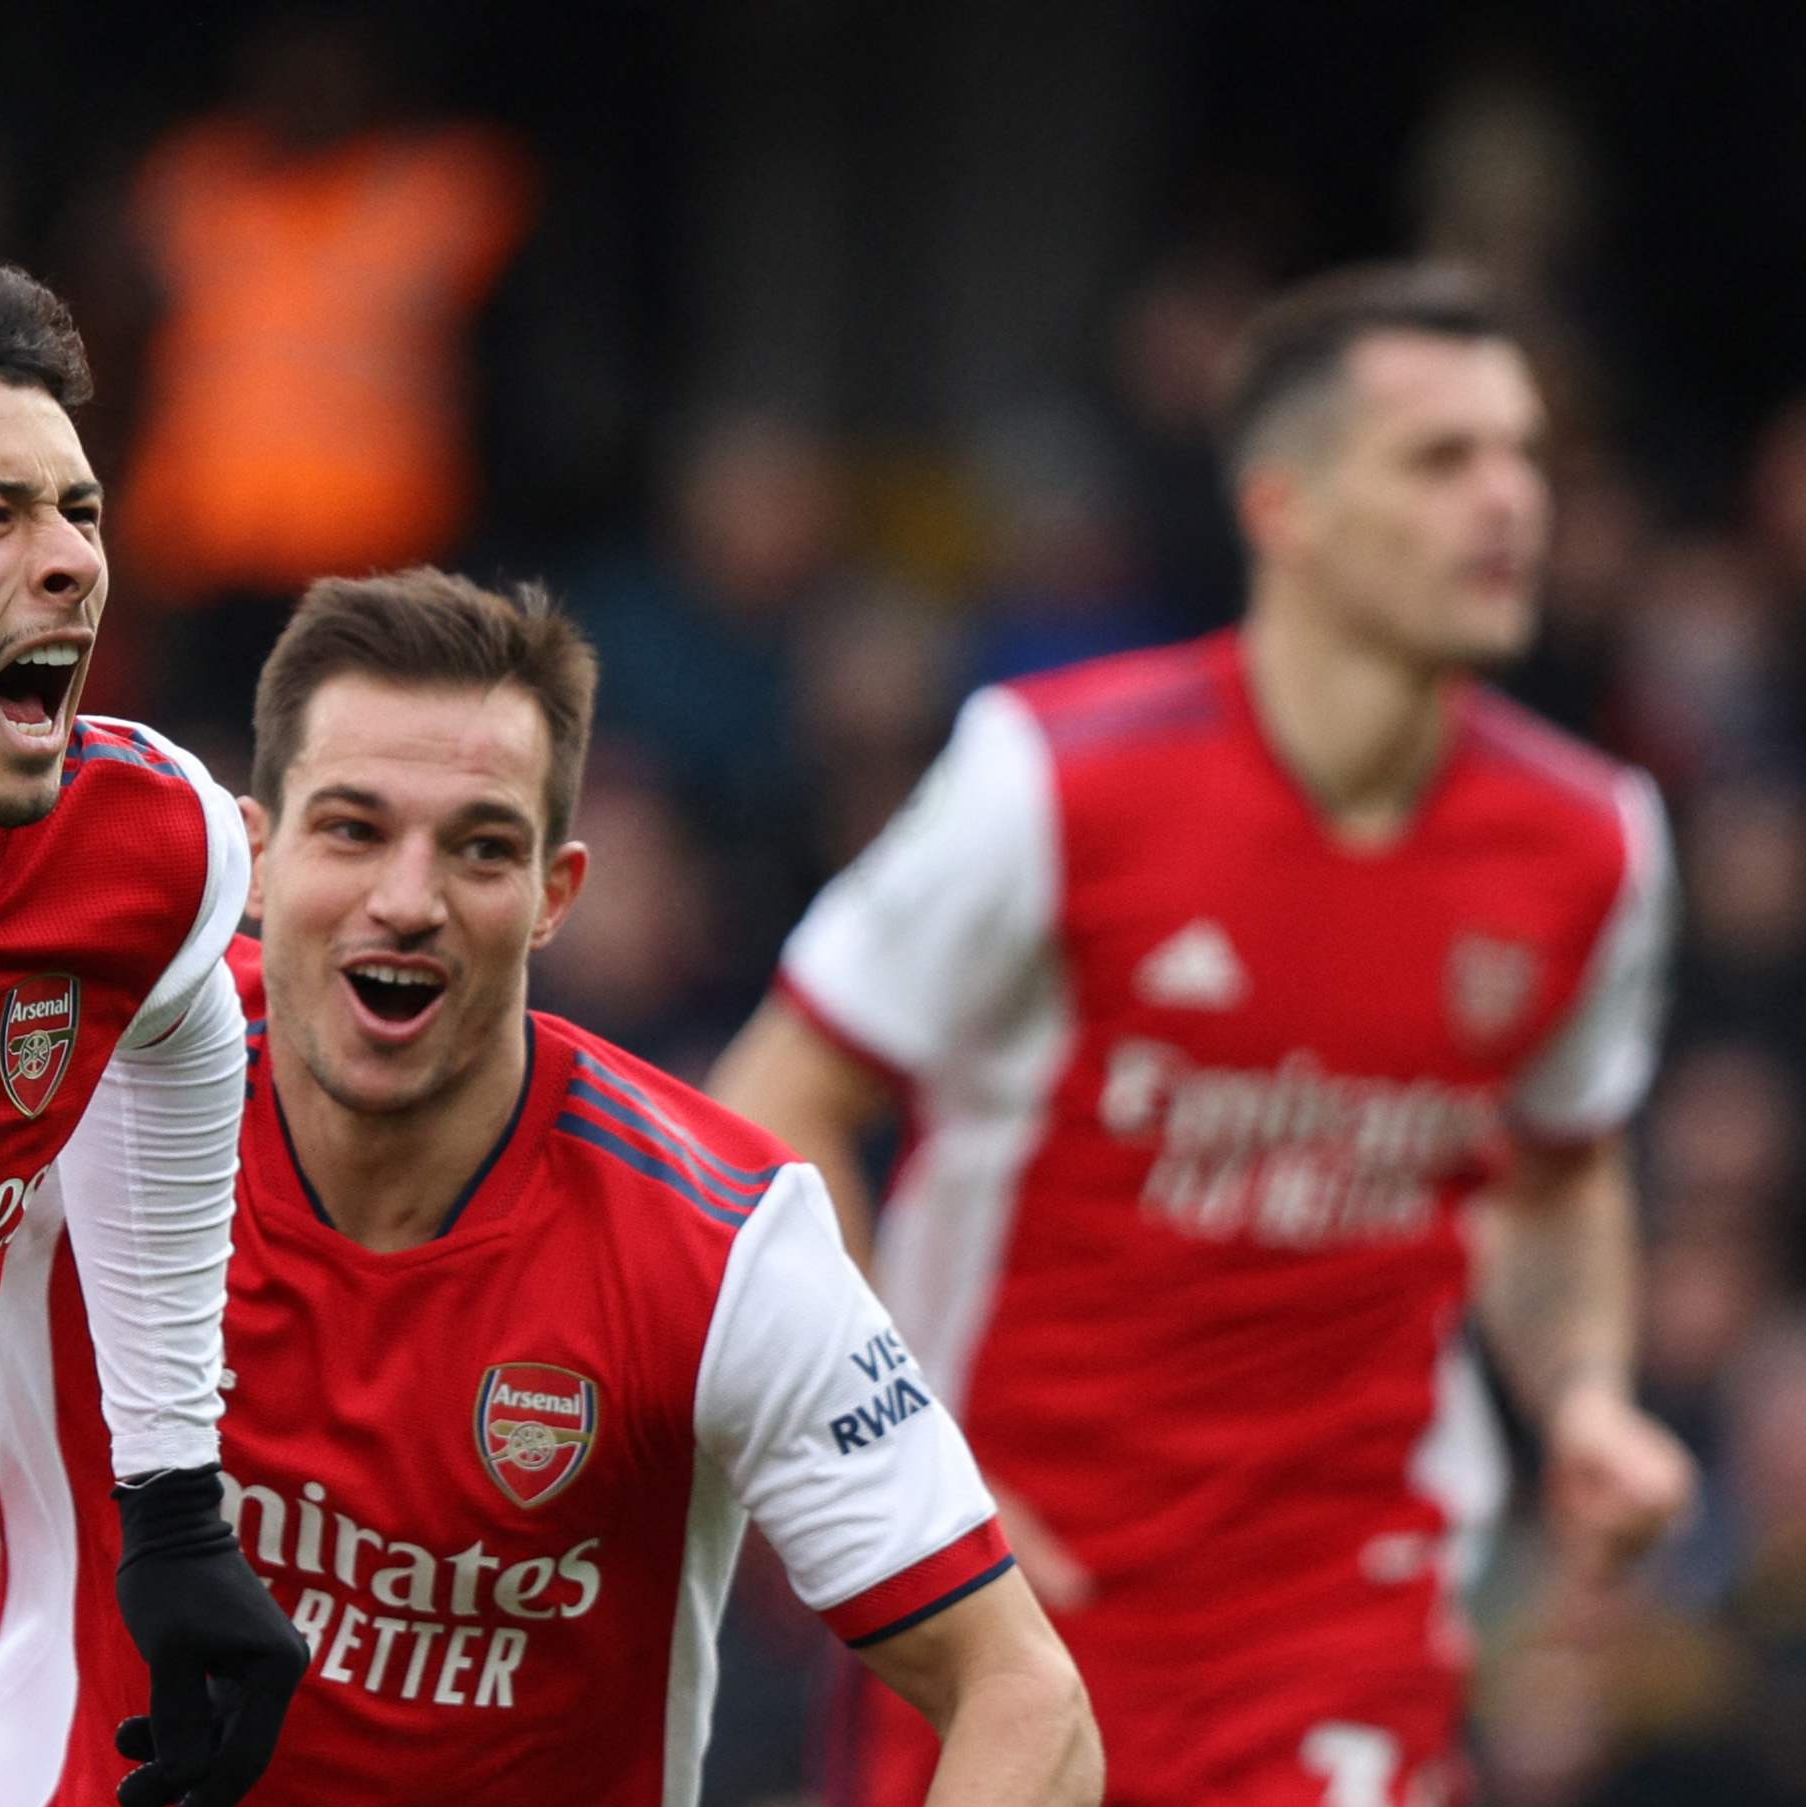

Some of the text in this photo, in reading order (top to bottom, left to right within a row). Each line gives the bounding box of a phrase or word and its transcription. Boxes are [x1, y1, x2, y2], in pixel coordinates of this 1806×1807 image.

[9, 992, 69, 1024] Arsenal
[850, 1328, 908, 1383] VIS
[492, 1383, 582, 1417] Arsenal
[829, 1377, 931, 1456] RWA
[220, 1469, 602, 1620] mirates
